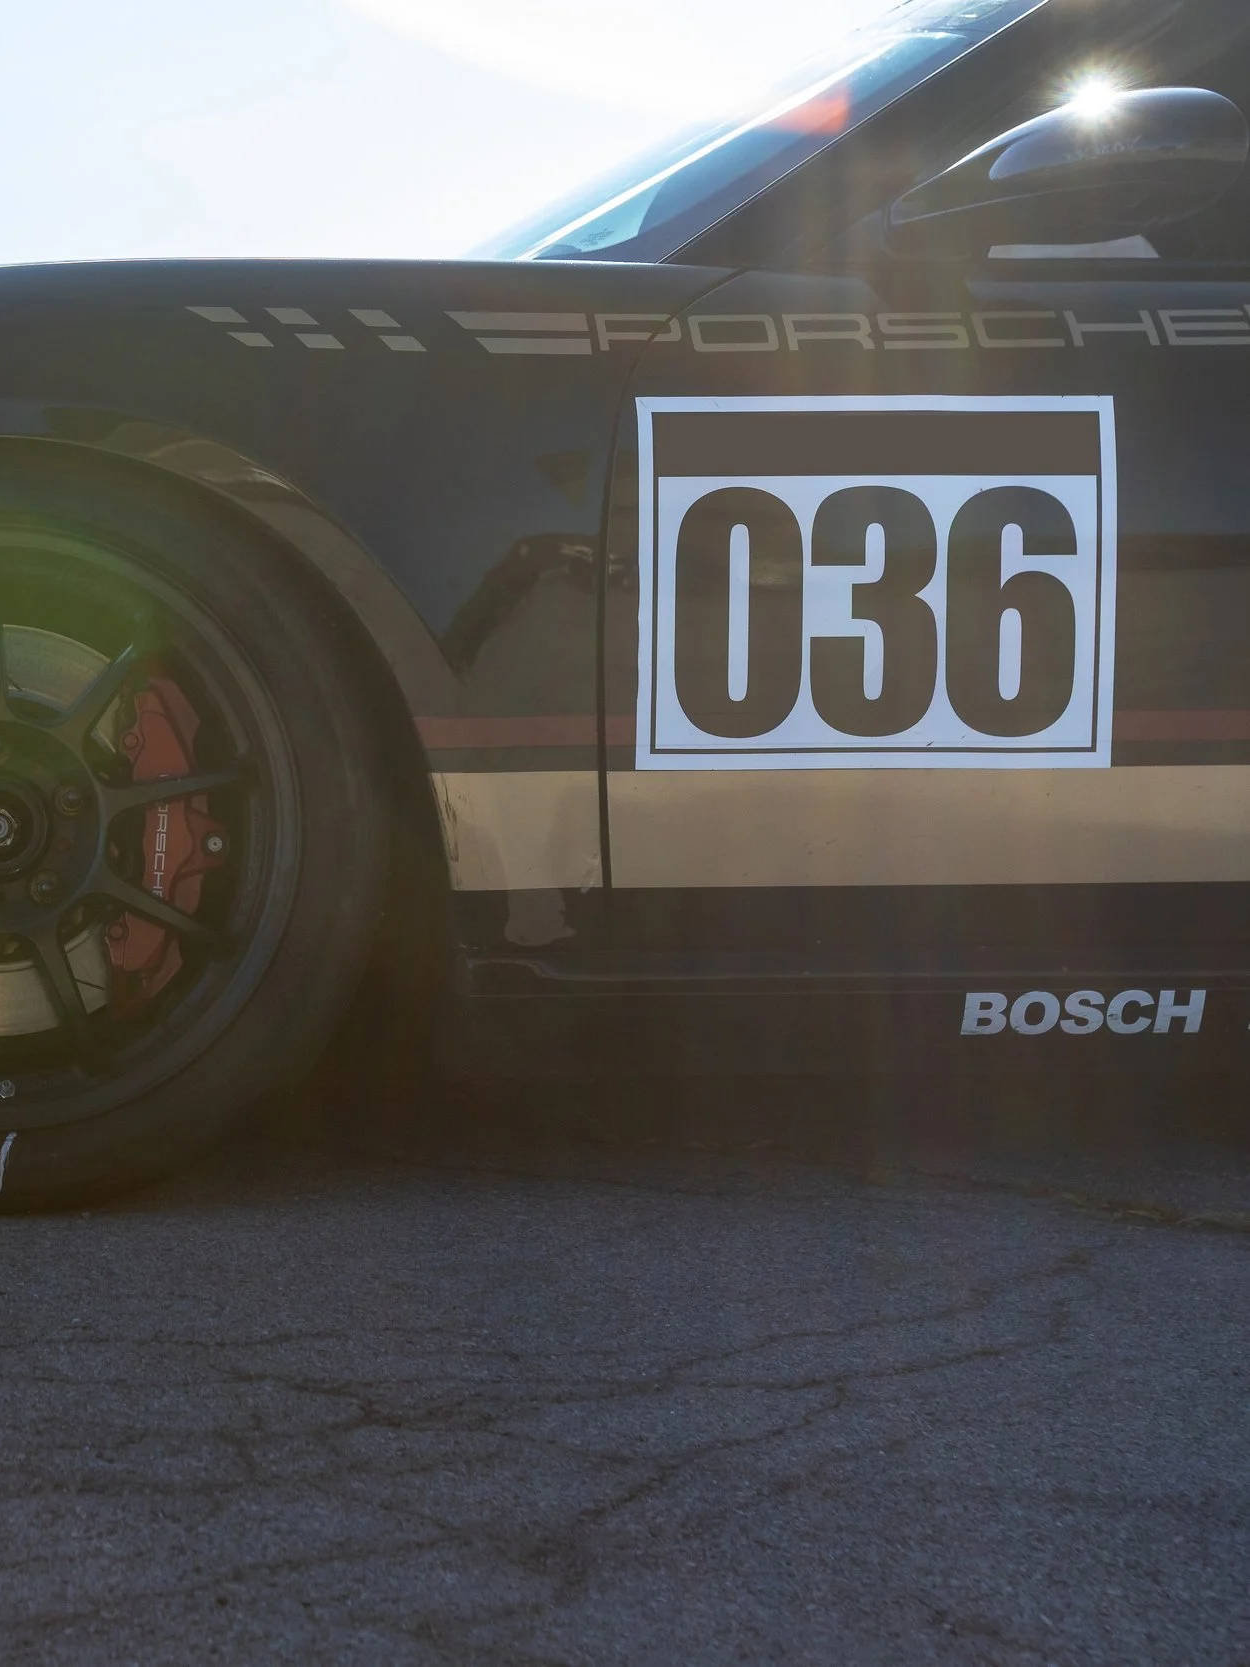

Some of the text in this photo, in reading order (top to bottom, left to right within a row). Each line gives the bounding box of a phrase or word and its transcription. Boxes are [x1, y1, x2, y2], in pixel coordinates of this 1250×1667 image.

[594, 309, 1250, 353] PORSCHE
[674, 485, 1078, 739] 036
[152, 774, 168, 898] RSCH
[960, 989, 1207, 1035] BOSCH
